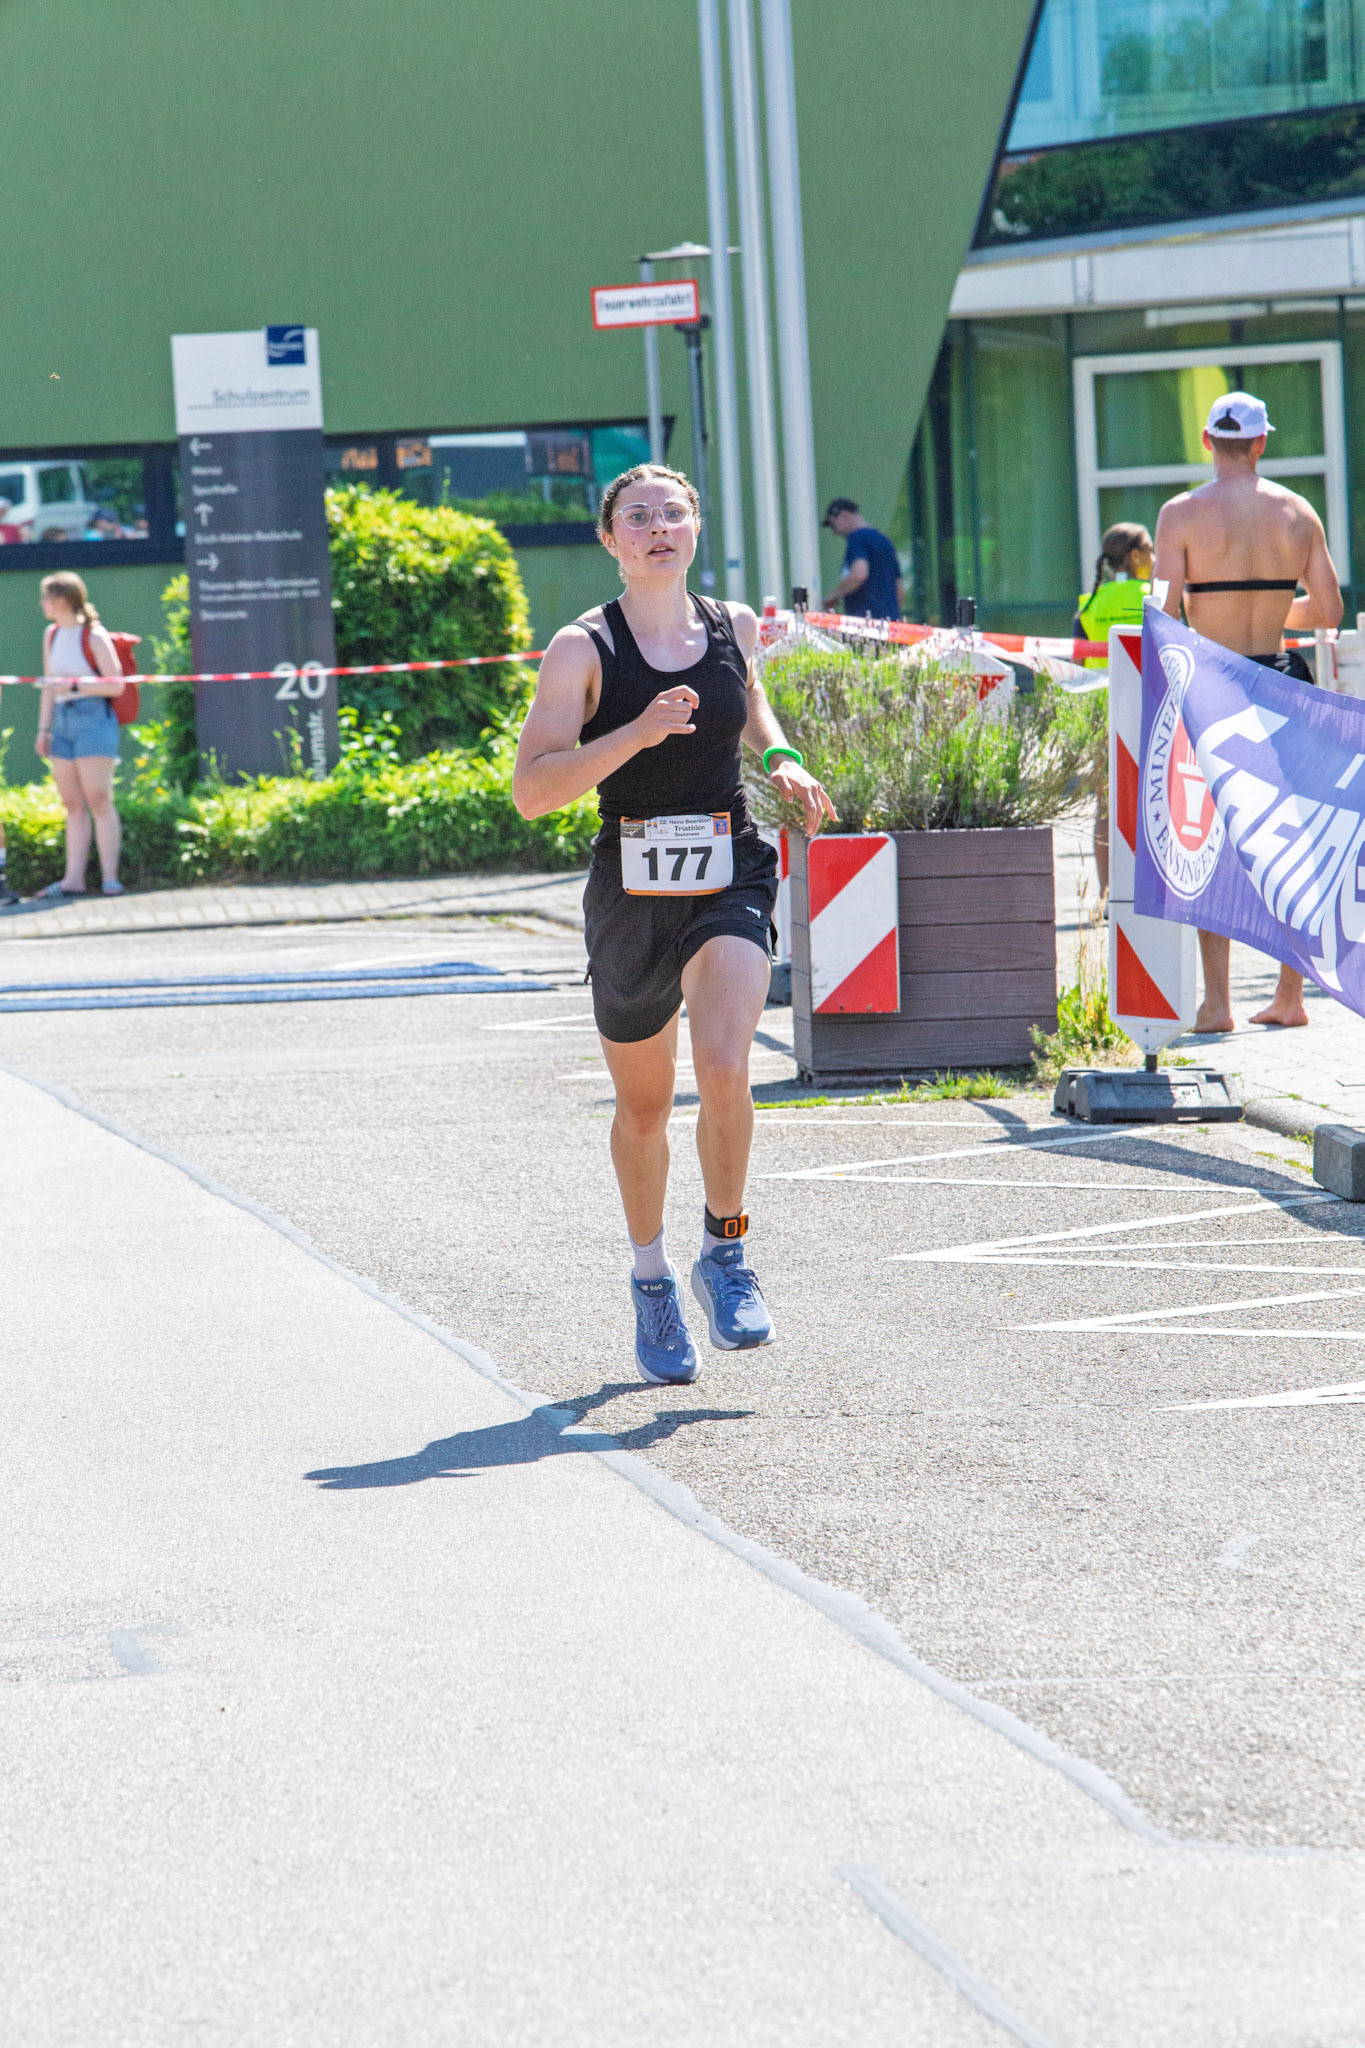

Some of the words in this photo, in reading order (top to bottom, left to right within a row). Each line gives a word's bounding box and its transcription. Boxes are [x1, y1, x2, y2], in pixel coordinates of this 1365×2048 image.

[273, 660, 328, 701] 20
[674, 824, 705, 832] Triathlon
[642, 846, 712, 881] 177
[1156, 825, 1216, 885] ENSINGEN
